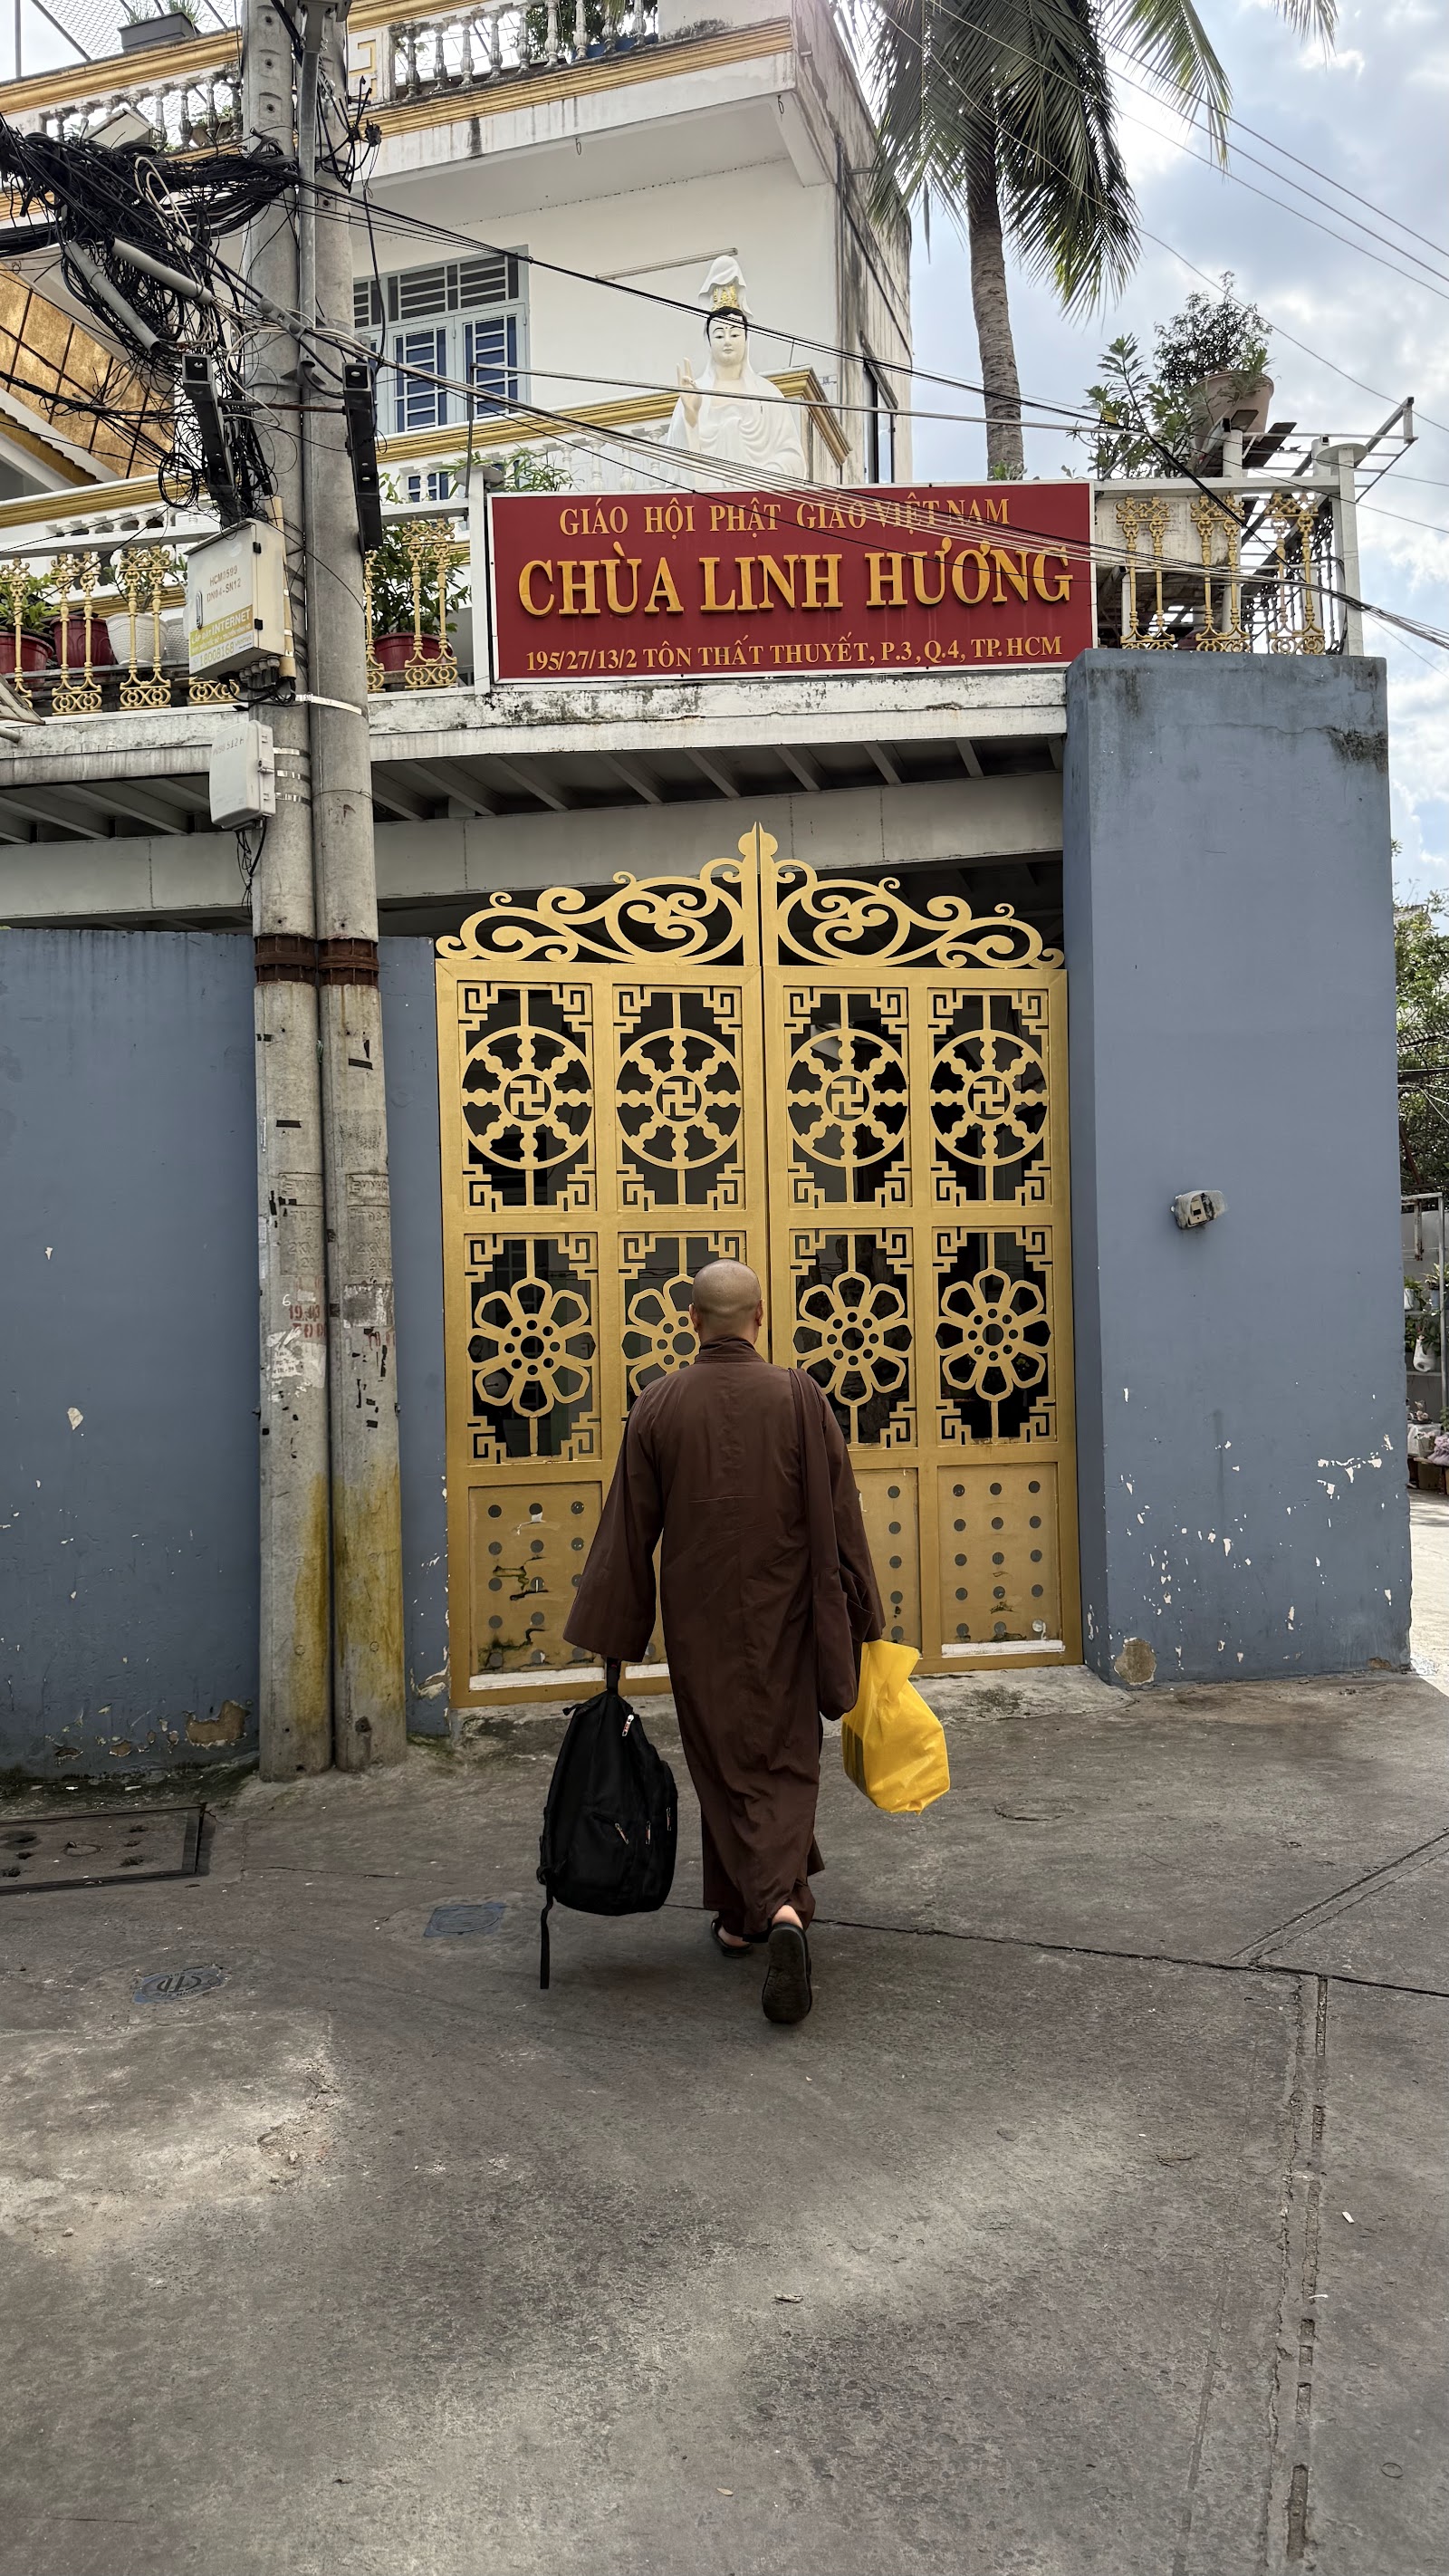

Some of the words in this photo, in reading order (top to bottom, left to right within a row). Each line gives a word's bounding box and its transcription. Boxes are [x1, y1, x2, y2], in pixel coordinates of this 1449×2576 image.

[559, 497, 629, 536] GIÁO
[644, 497, 696, 541] HỘI
[709, 496, 782, 539] PHẬT
[796, 494, 868, 530] GIÁO
[873, 492, 940, 535] VIỆT
[945, 498, 1010, 527] NAM
[518, 541, 685, 618] CHÙA
[698, 553, 844, 616] LINH
[864, 536, 1074, 608] HƯƠNG
[212, 608, 251, 636] INTERNET
[525, 649, 638, 672] 195/27/13/2
[642, 640, 692, 668] TÔN
[697, 635, 764, 667] THẤT
[770, 631, 876, 666] THUYẾT,
[880, 640, 922, 665] P.3,
[924, 639, 966, 663] Q.4,
